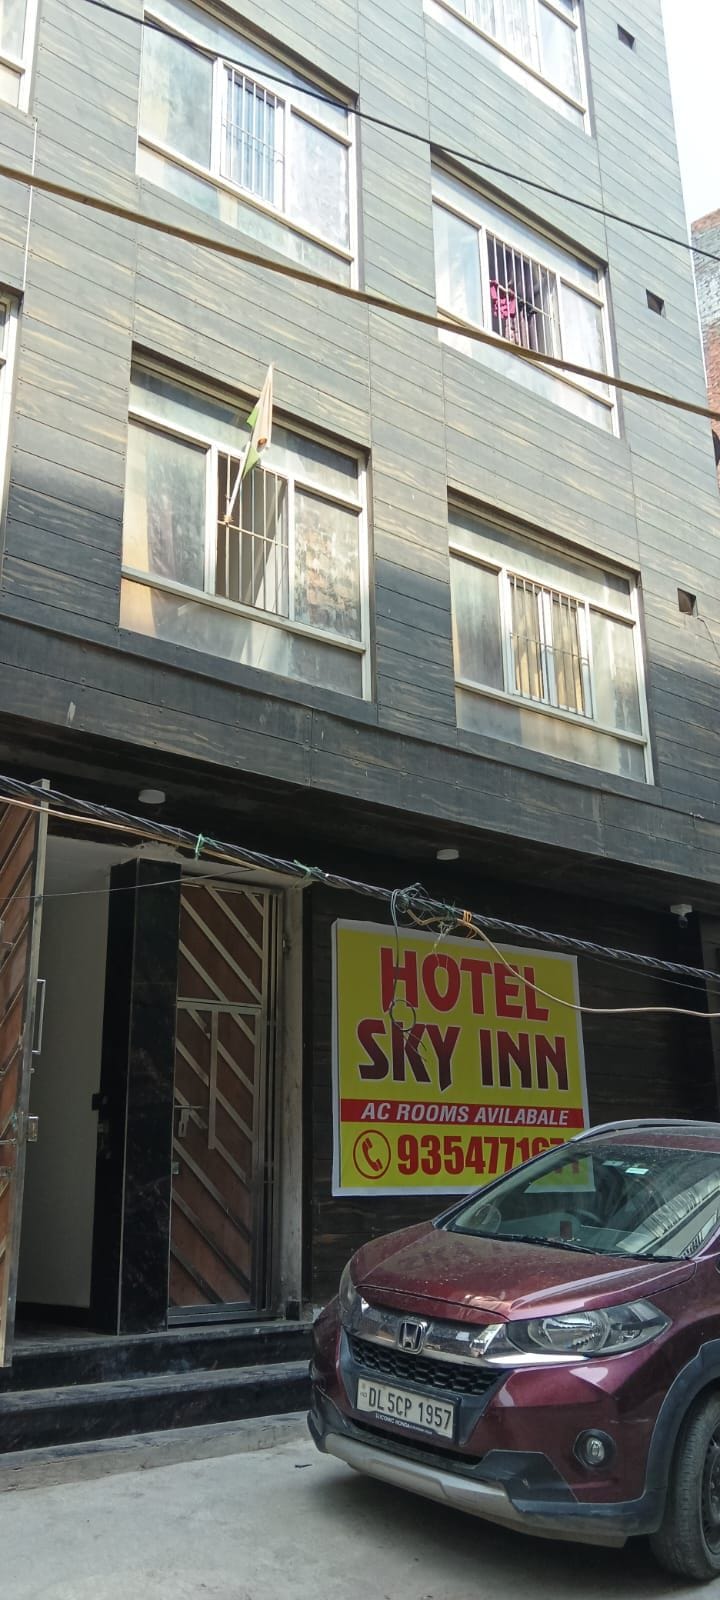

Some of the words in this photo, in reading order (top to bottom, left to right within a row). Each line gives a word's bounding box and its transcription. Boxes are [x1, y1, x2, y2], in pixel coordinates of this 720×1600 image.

[380, 948, 549, 1021] HOTEL
[357, 1018, 461, 1091] SKY
[479, 1029, 569, 1090] INN
[361, 1102, 391, 1120] AC
[396, 1103, 469, 1122] ROOMS
[474, 1106, 569, 1126] AVILABALE
[368, 1387, 385, 1411] DL
[387, 1392, 412, 1417] 5CP
[418, 1402, 451, 1430] 1957
